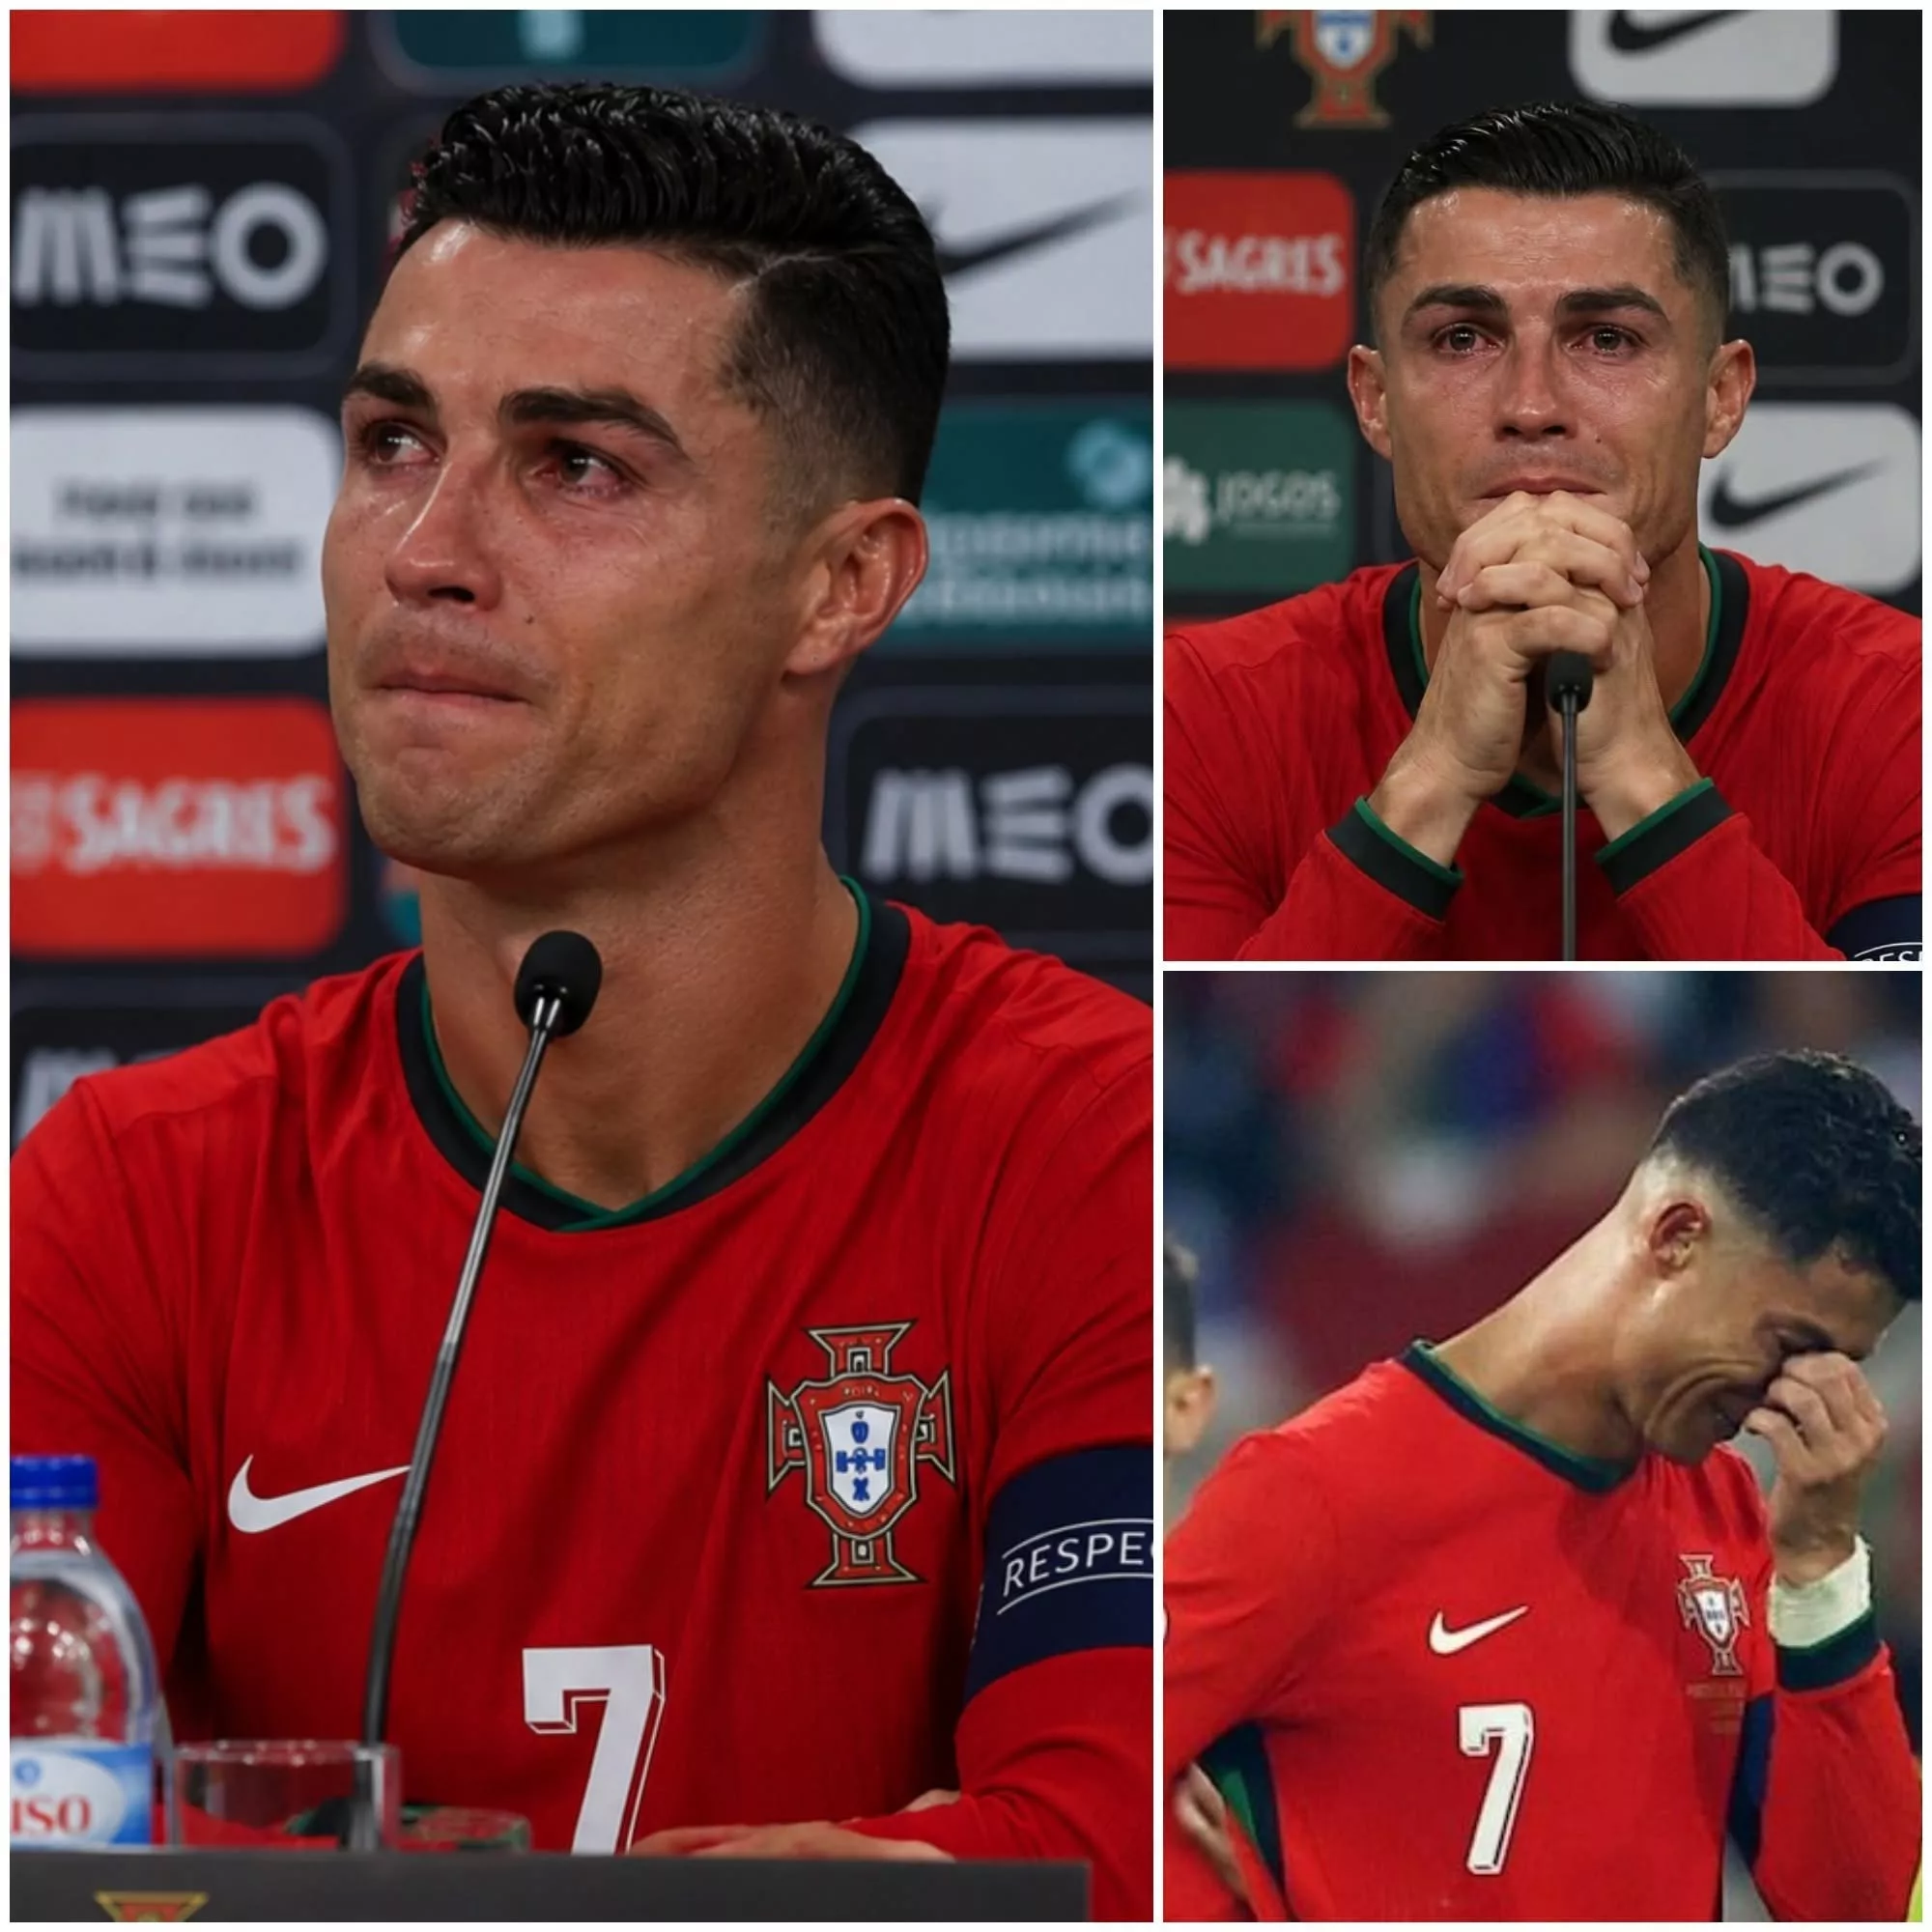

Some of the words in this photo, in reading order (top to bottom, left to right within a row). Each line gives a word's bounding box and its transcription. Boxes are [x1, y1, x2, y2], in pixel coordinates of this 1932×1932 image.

[14, 182, 328, 312] MEO
[864, 762, 1151, 886] MEO
[1002, 1530, 1153, 1598] RESPE
[523, 1644, 666, 1856] 7
[1459, 1703, 1534, 1875] 7
